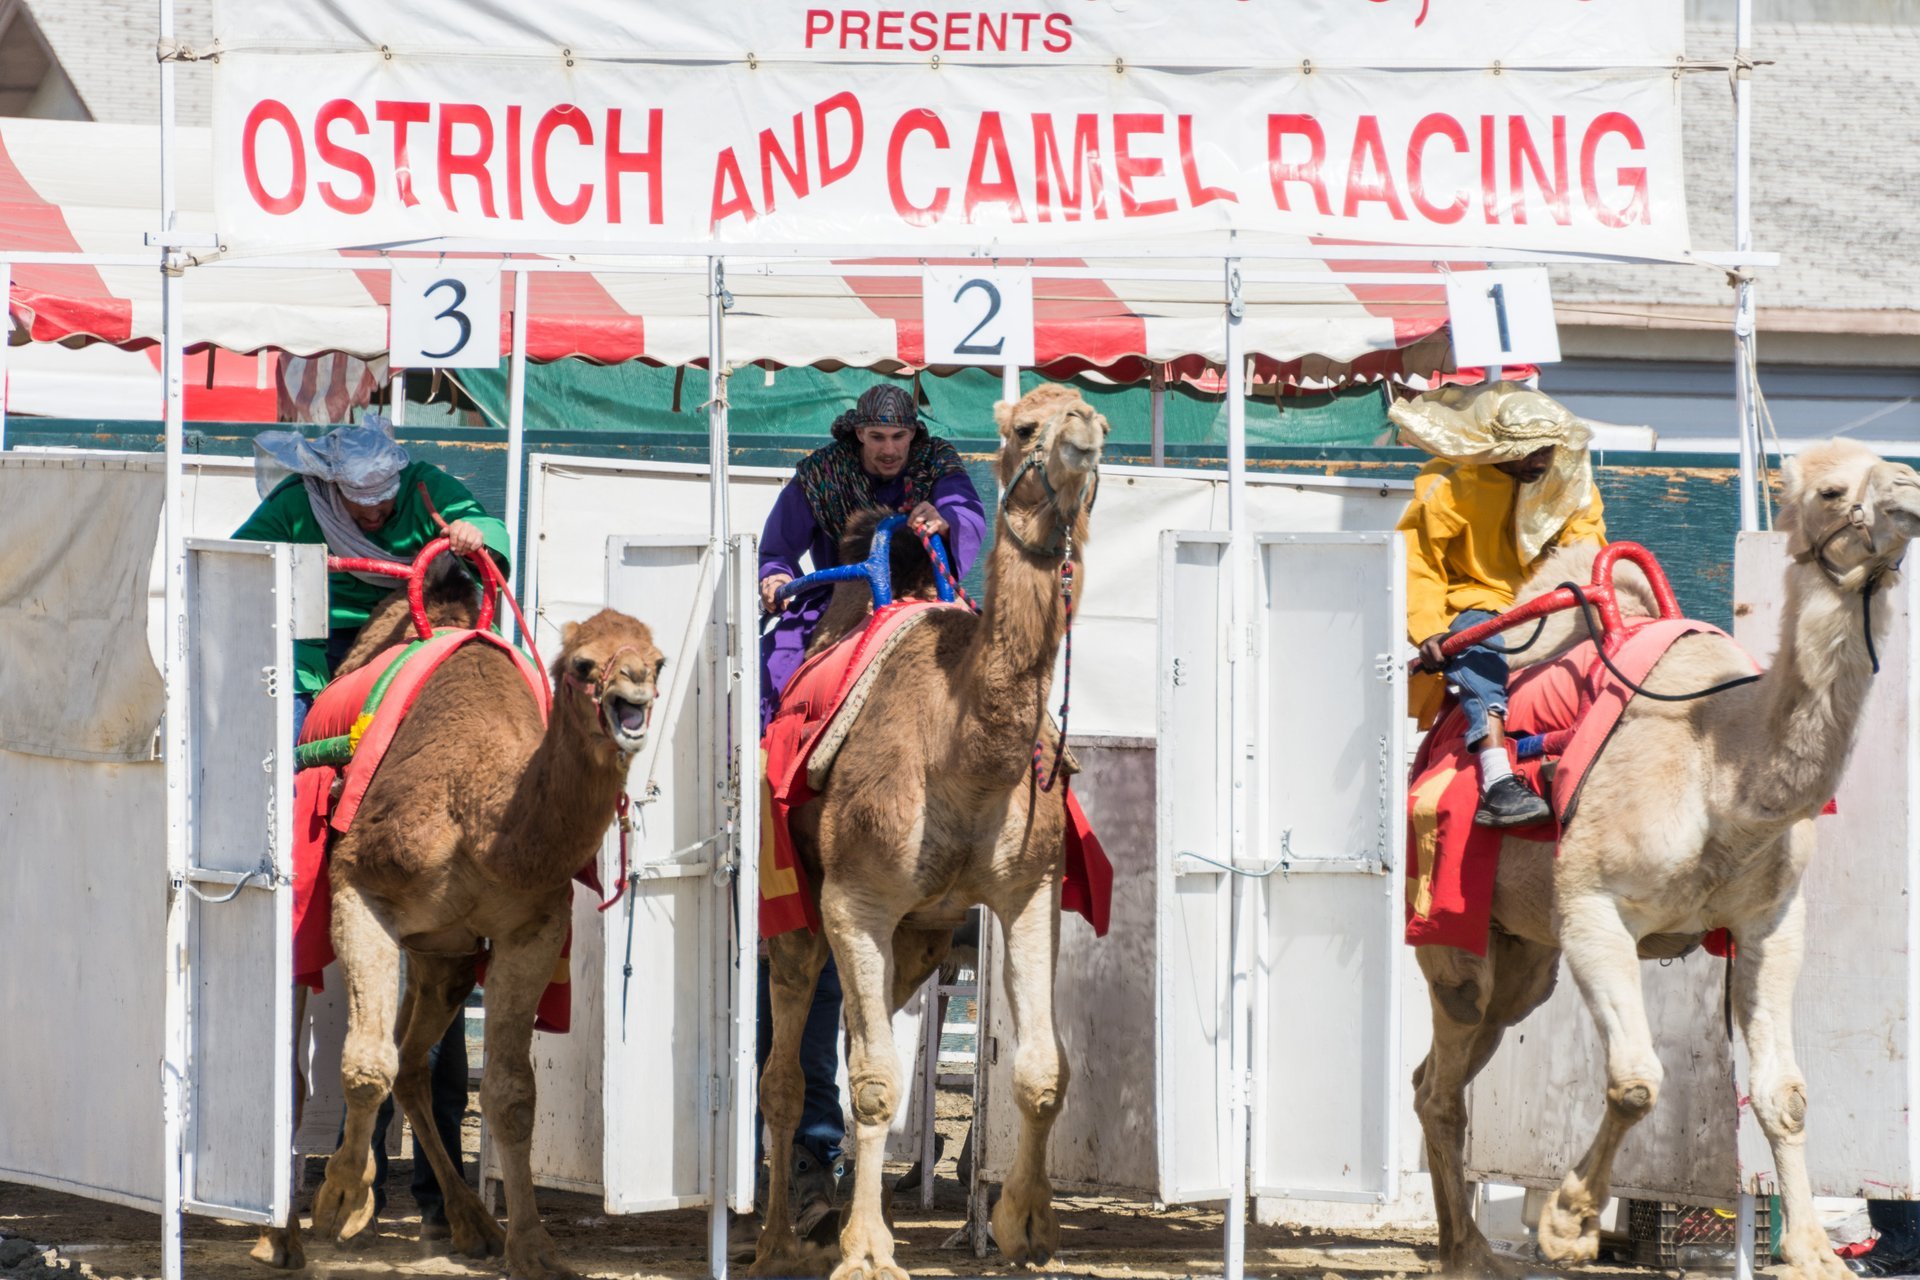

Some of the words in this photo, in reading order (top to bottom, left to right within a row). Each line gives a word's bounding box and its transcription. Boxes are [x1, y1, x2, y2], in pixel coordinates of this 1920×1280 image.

[804, 9, 1073, 53] PRESENTS
[241, 98, 665, 226] OSTRICH
[709, 90, 865, 235] AND
[885, 108, 1239, 227] CAMEL
[1266, 111, 1652, 229] RACING
[420, 278, 472, 359] 3
[953, 279, 1006, 355] 2
[1486, 283, 1513, 353] 1
